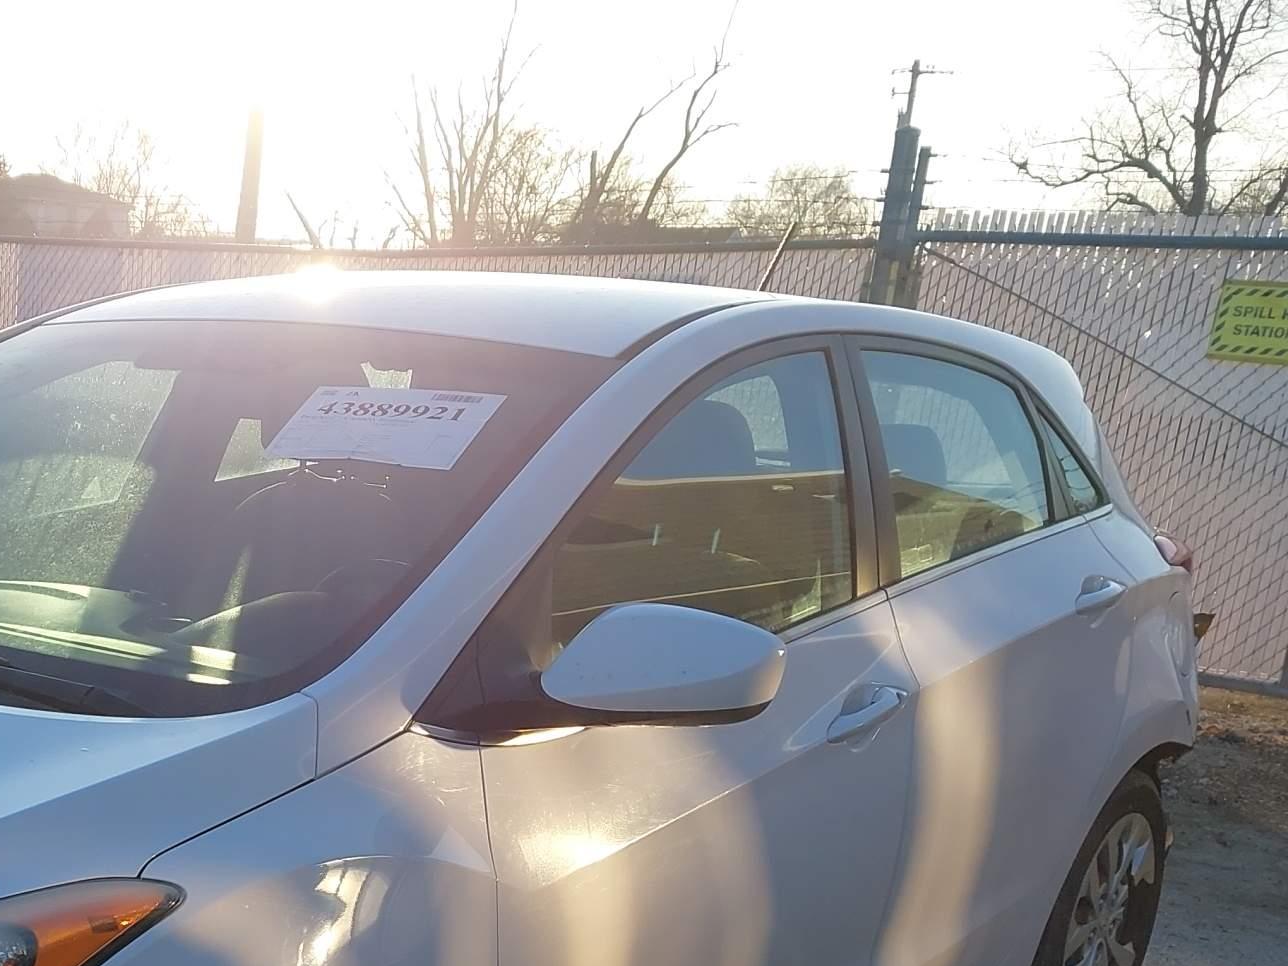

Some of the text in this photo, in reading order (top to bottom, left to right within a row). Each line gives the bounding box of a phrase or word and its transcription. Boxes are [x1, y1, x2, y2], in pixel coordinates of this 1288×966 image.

[1233, 306, 1275, 319] SPILL
[1233, 324, 1288, 338] STATIO
[317, 401, 466, 421] 43889921
